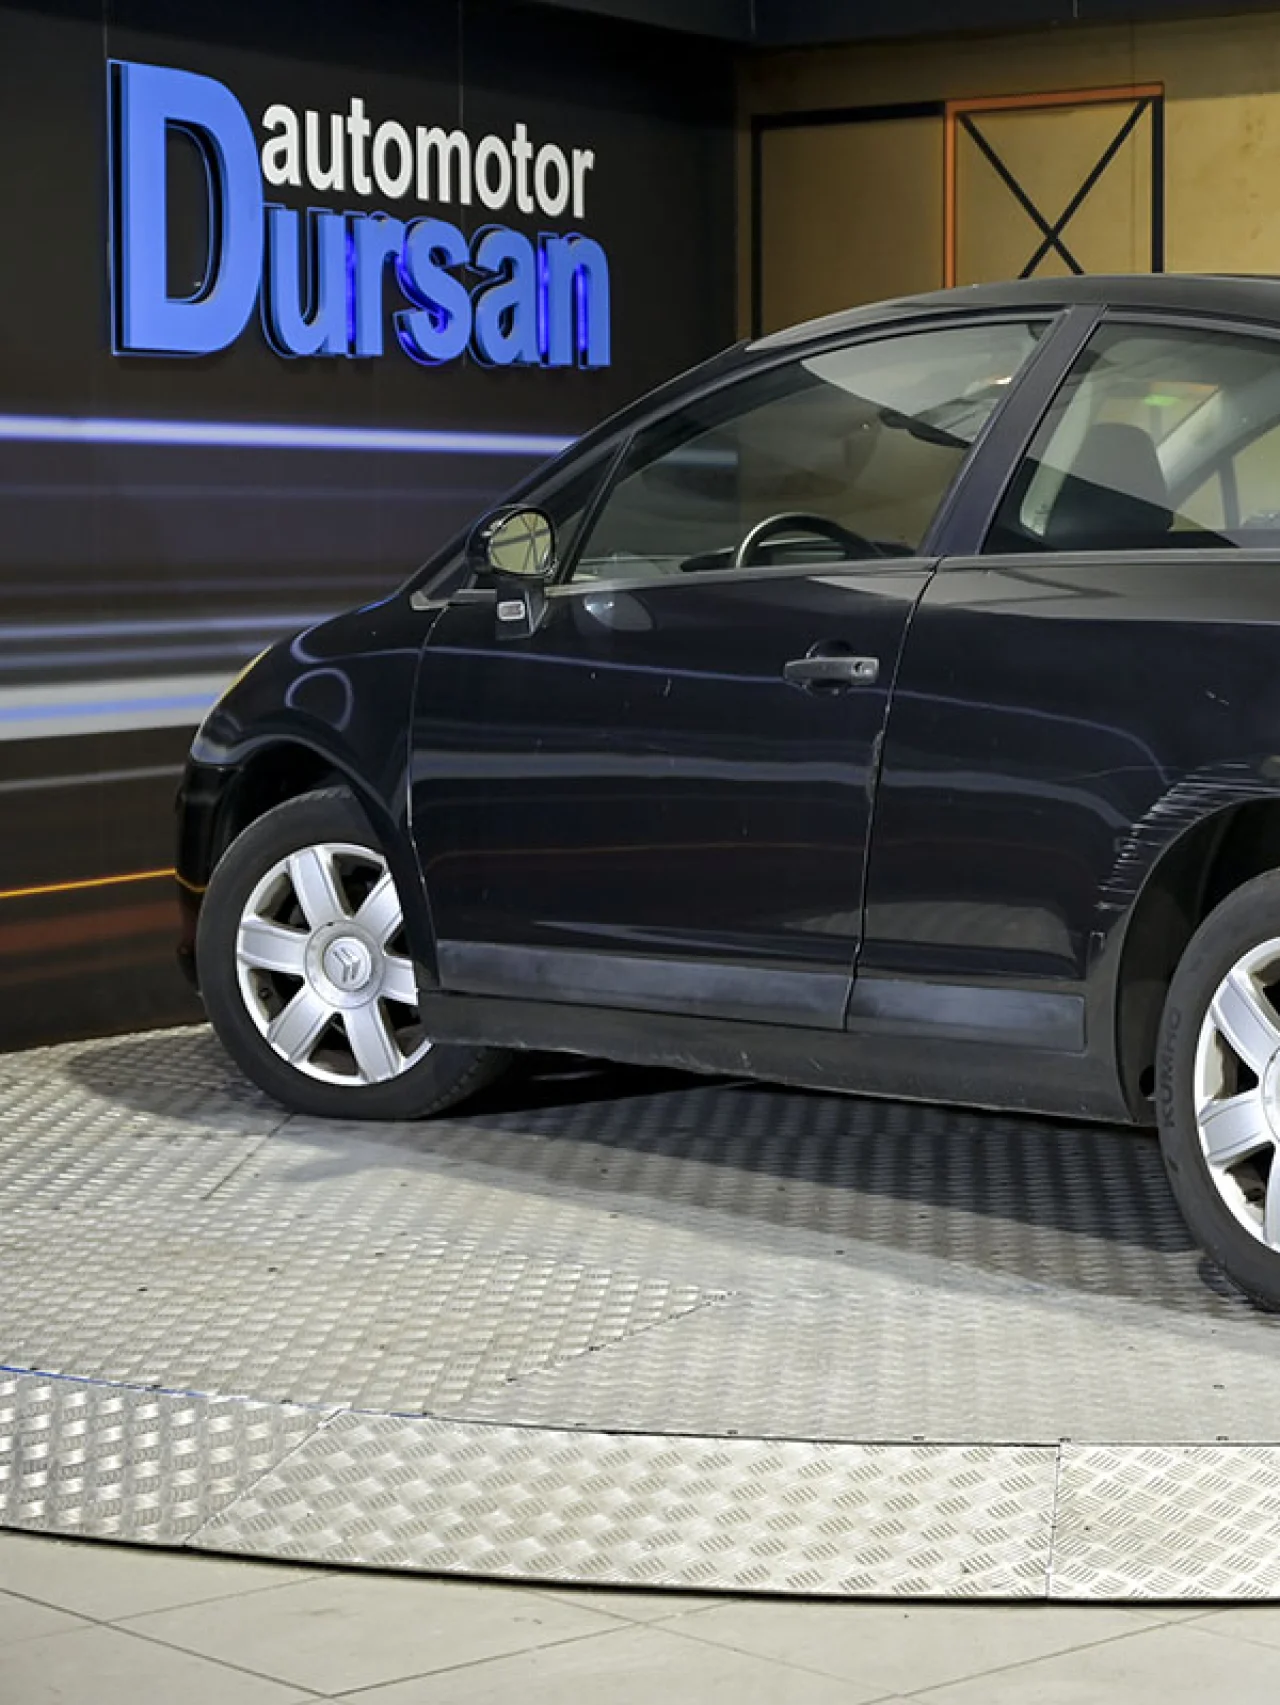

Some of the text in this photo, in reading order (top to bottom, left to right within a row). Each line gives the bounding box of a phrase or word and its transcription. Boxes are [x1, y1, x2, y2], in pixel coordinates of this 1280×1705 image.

[107, 58, 611, 369] Dursan
[261, 97, 595, 218] automotor
[1158, 1006, 1184, 1129] KUMHO
